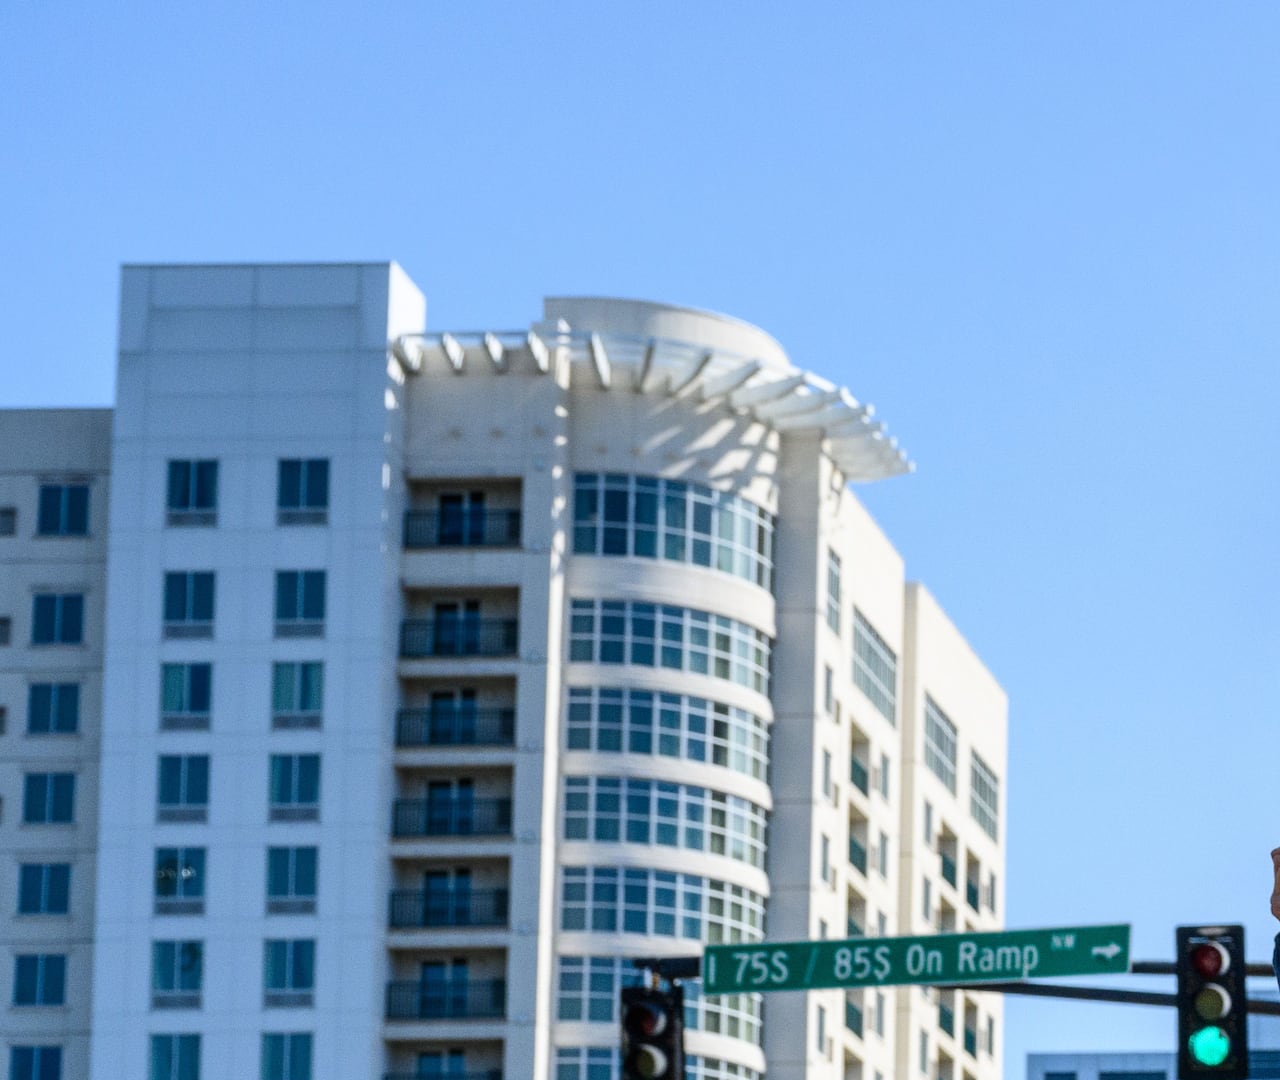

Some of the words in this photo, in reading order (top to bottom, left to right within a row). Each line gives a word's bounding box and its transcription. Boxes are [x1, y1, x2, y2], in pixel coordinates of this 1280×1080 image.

[708, 953, 717, 986] I
[732, 950, 790, 985] 75S
[905, 943, 944, 977] On
[957, 940, 1039, 978] Ramp
